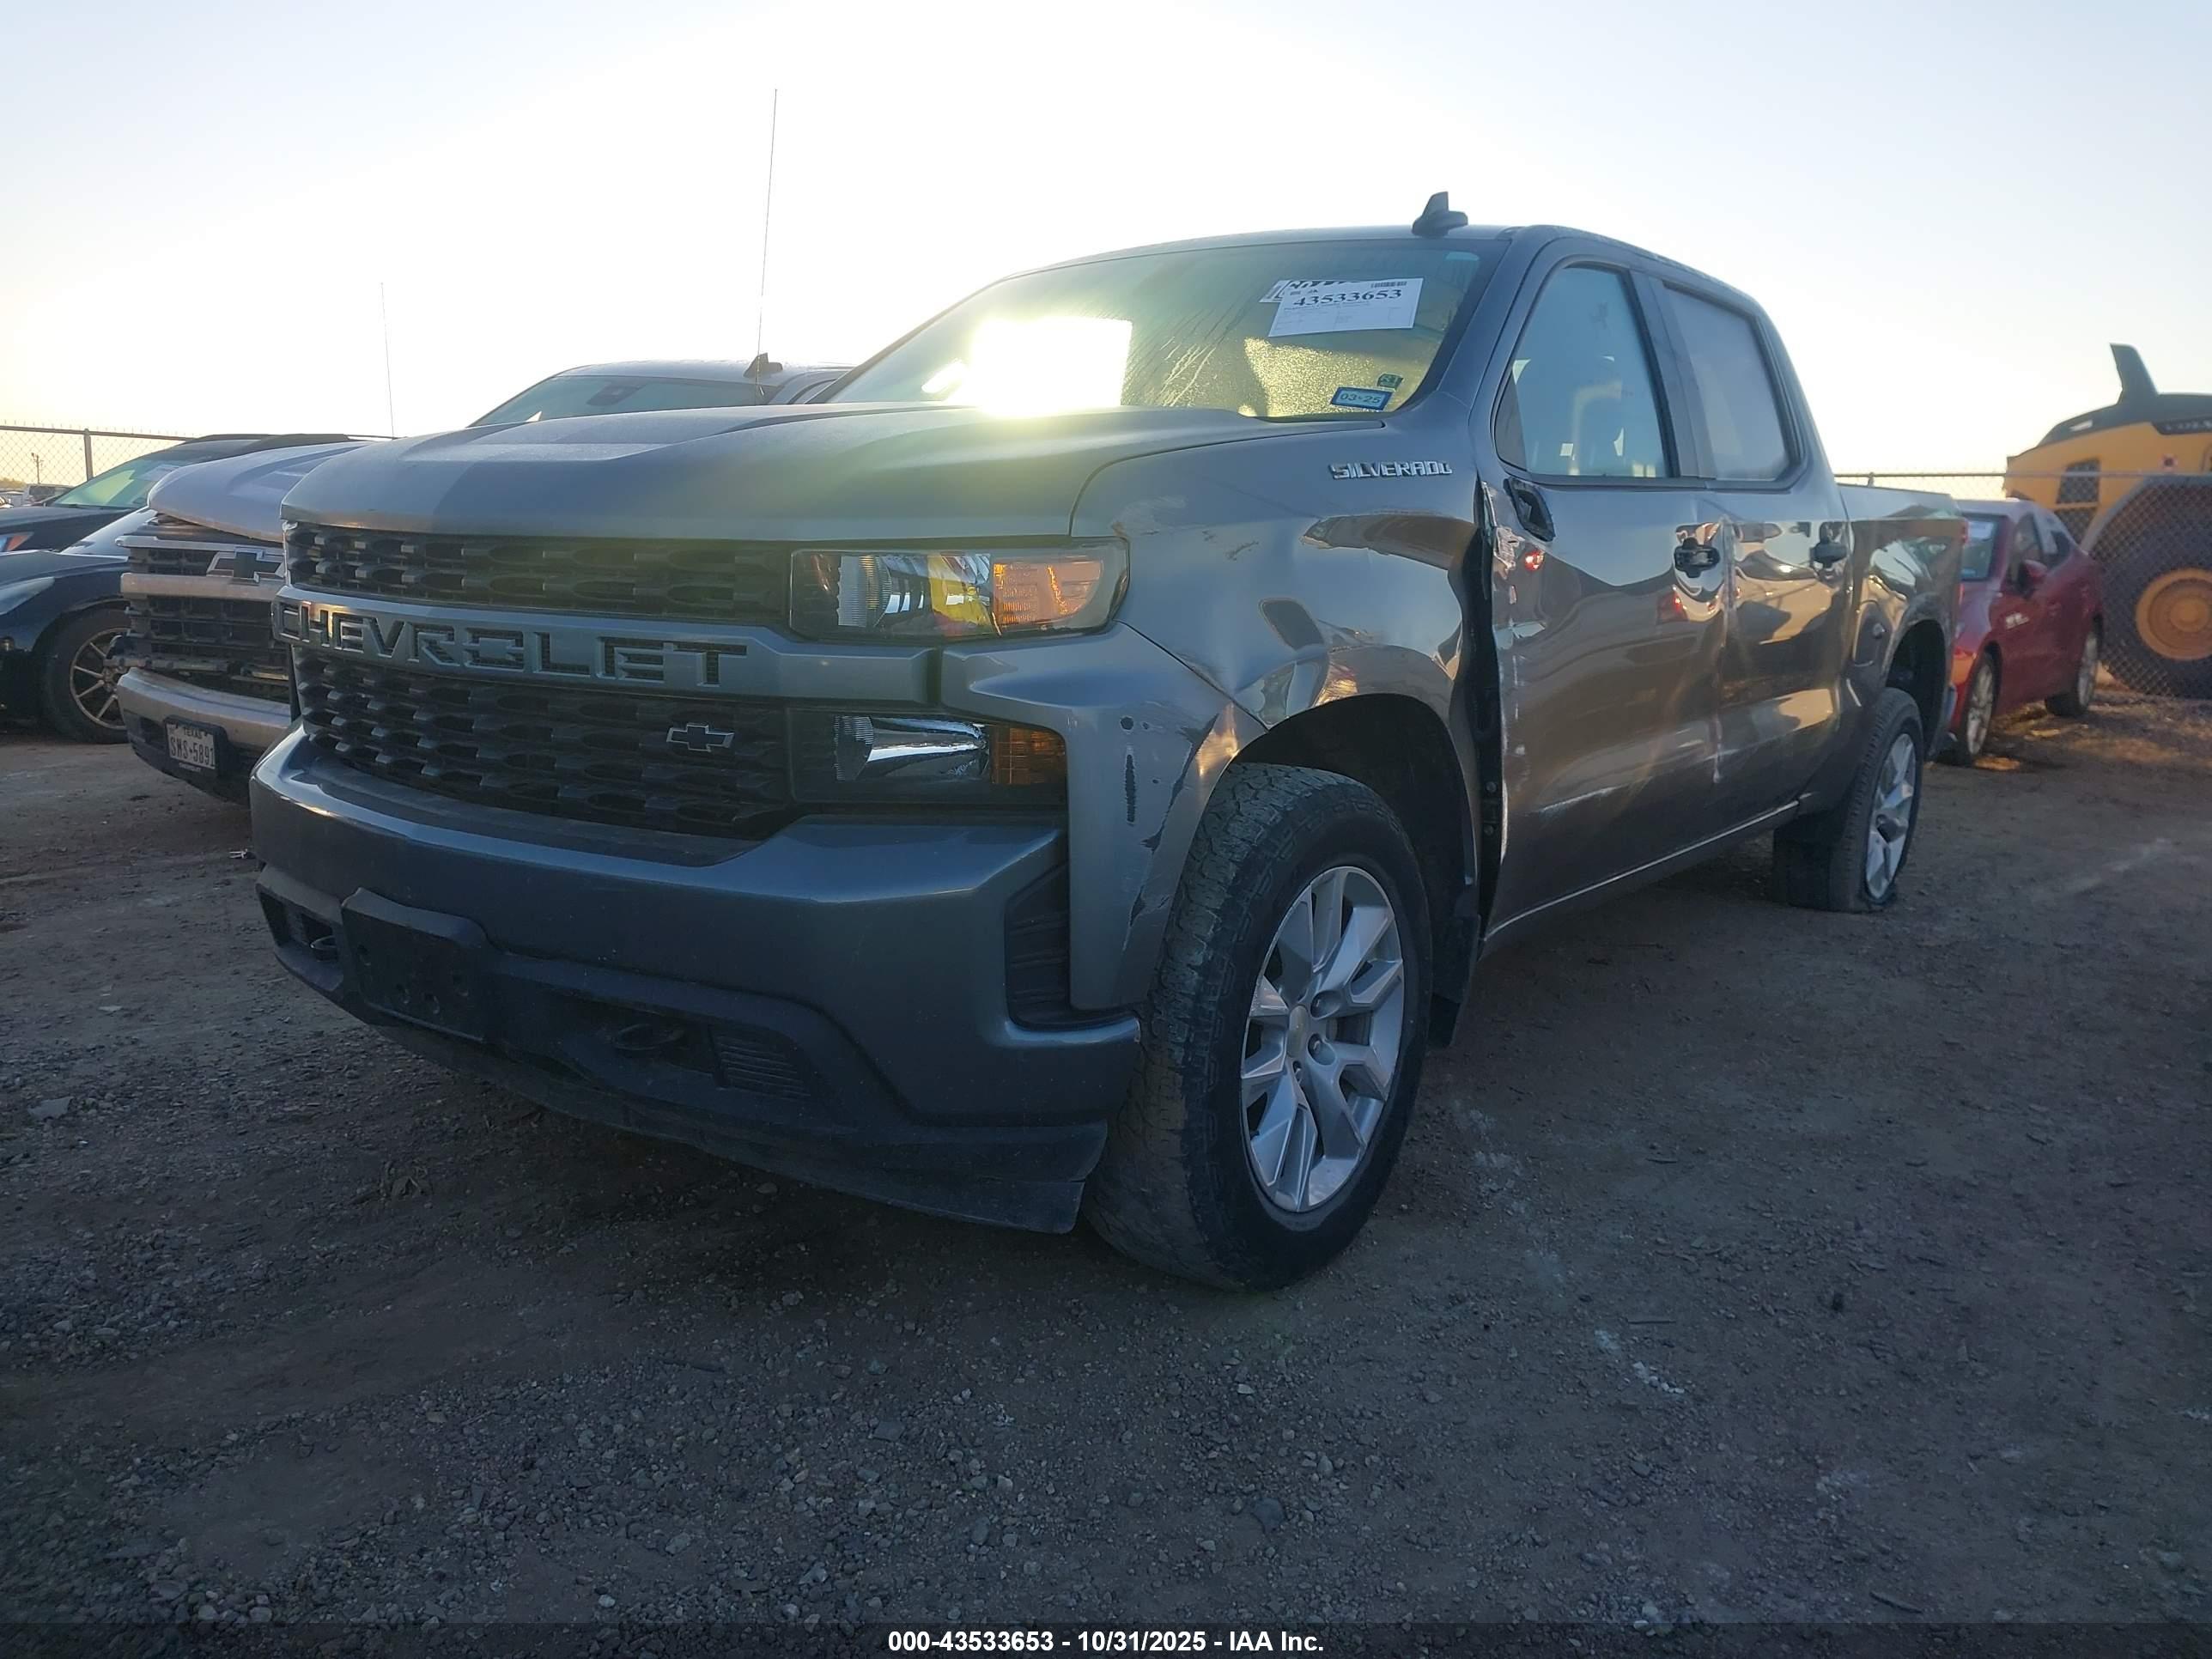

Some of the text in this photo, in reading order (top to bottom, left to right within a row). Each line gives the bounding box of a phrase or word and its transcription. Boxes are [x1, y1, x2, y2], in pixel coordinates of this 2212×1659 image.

[1293, 289, 1402, 307] 43533653
[1328, 460, 1453, 480] SILVERADO
[276, 601, 748, 686] CHEVROLET
